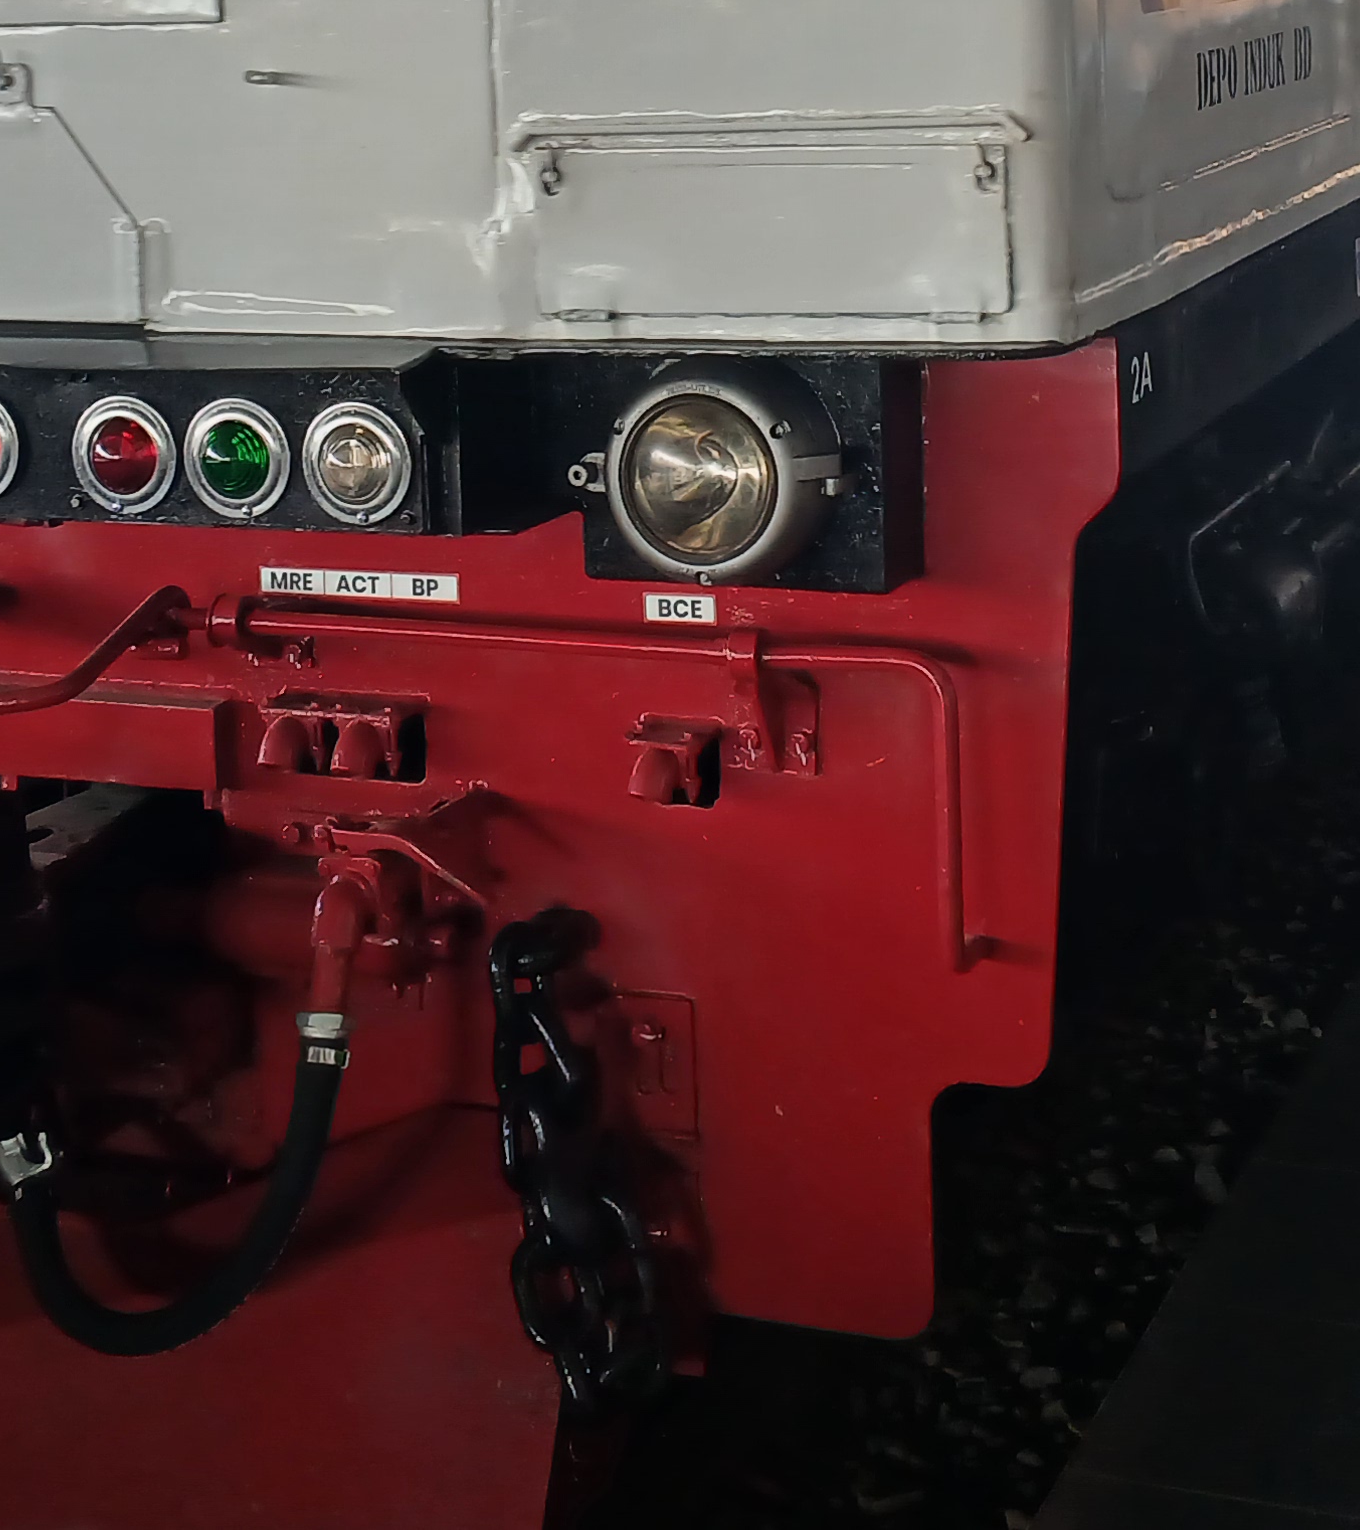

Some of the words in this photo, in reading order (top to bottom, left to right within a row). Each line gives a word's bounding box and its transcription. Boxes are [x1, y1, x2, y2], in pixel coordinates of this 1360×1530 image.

[1196, 45, 1238, 111] DEPO
[1244, 31, 1286, 96] INDUK
[1293, 26, 1312, 82] BD
[1130, 351, 1153, 405] 2A
[269, 572, 313, 591] MRE
[335, 574, 380, 594] ACT
[411, 578, 439, 597] BP
[657, 599, 703, 619] BCE
